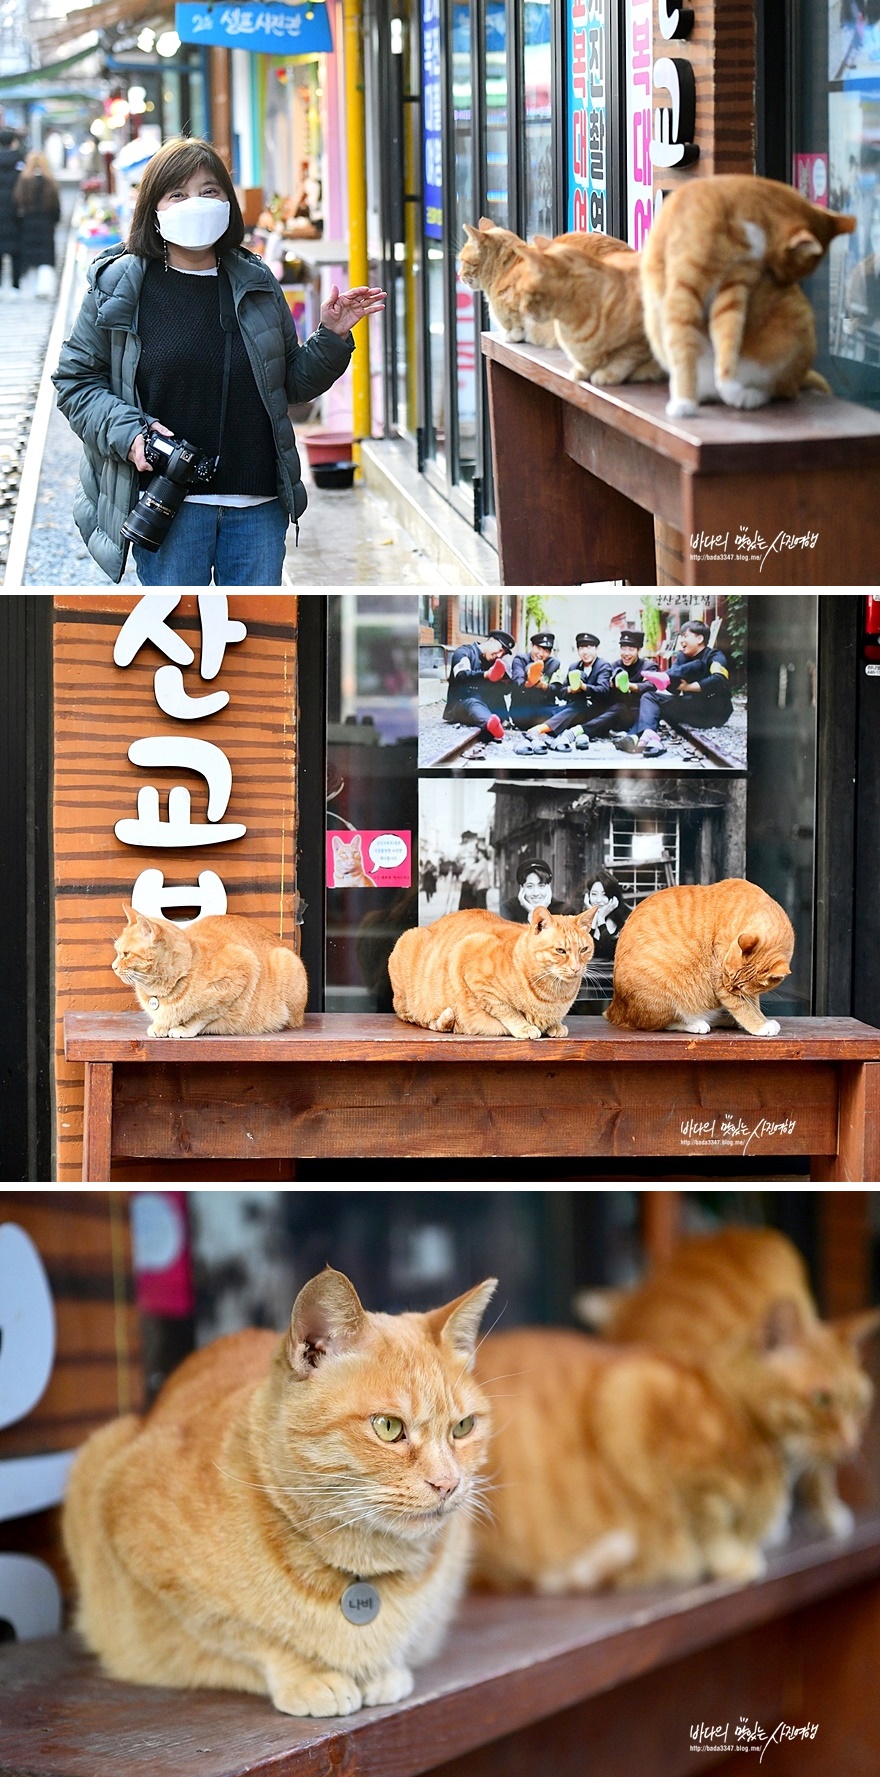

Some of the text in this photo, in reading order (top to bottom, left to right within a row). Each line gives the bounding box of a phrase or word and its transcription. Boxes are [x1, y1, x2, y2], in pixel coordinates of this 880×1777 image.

[573, 0, 588, 232] 복대여
[588, 0, 605, 231] 진촬영
[632, 0, 652, 252] 복대여
[348, 1597, 373, 1611] 나비
